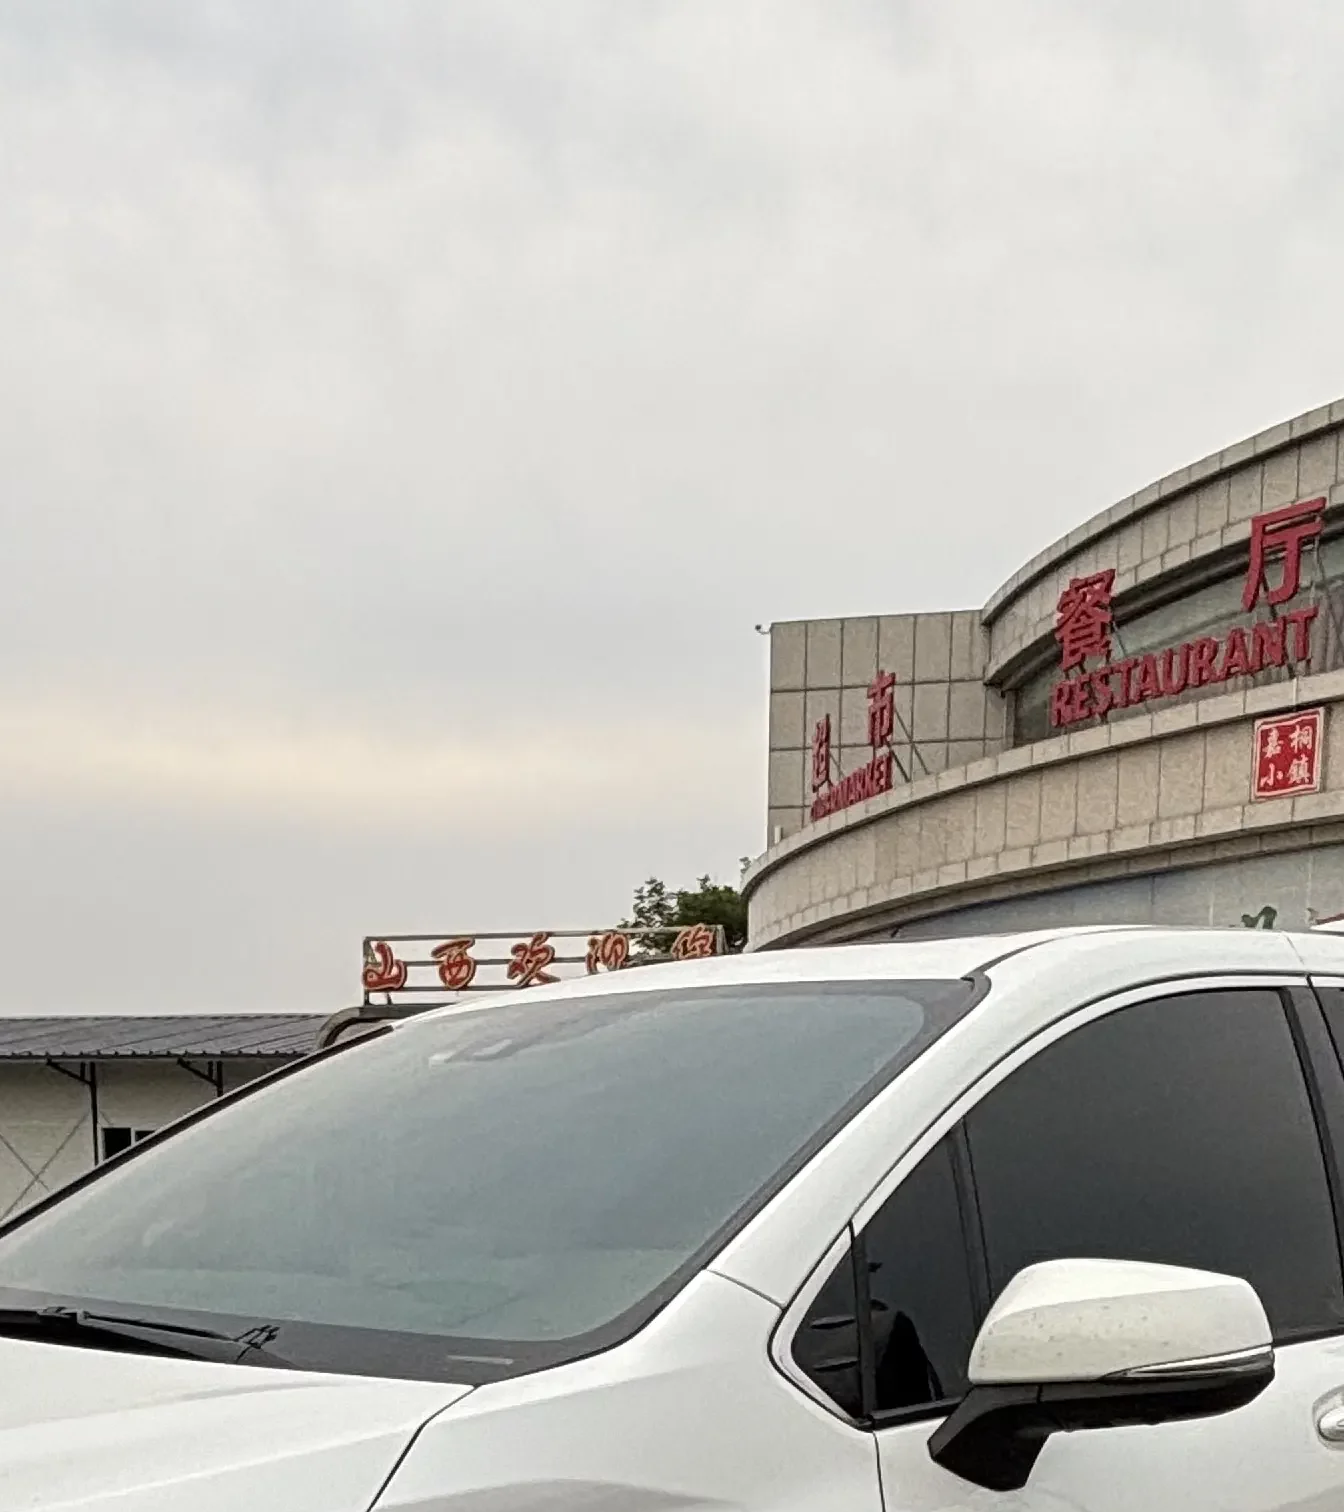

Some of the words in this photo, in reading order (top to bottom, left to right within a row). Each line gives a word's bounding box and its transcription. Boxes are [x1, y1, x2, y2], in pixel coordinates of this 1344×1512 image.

[1054, 496, 1328, 673] 餐厅
[1050, 605, 1320, 728] RESTAURANT
[811, 669, 896, 794] 超市
